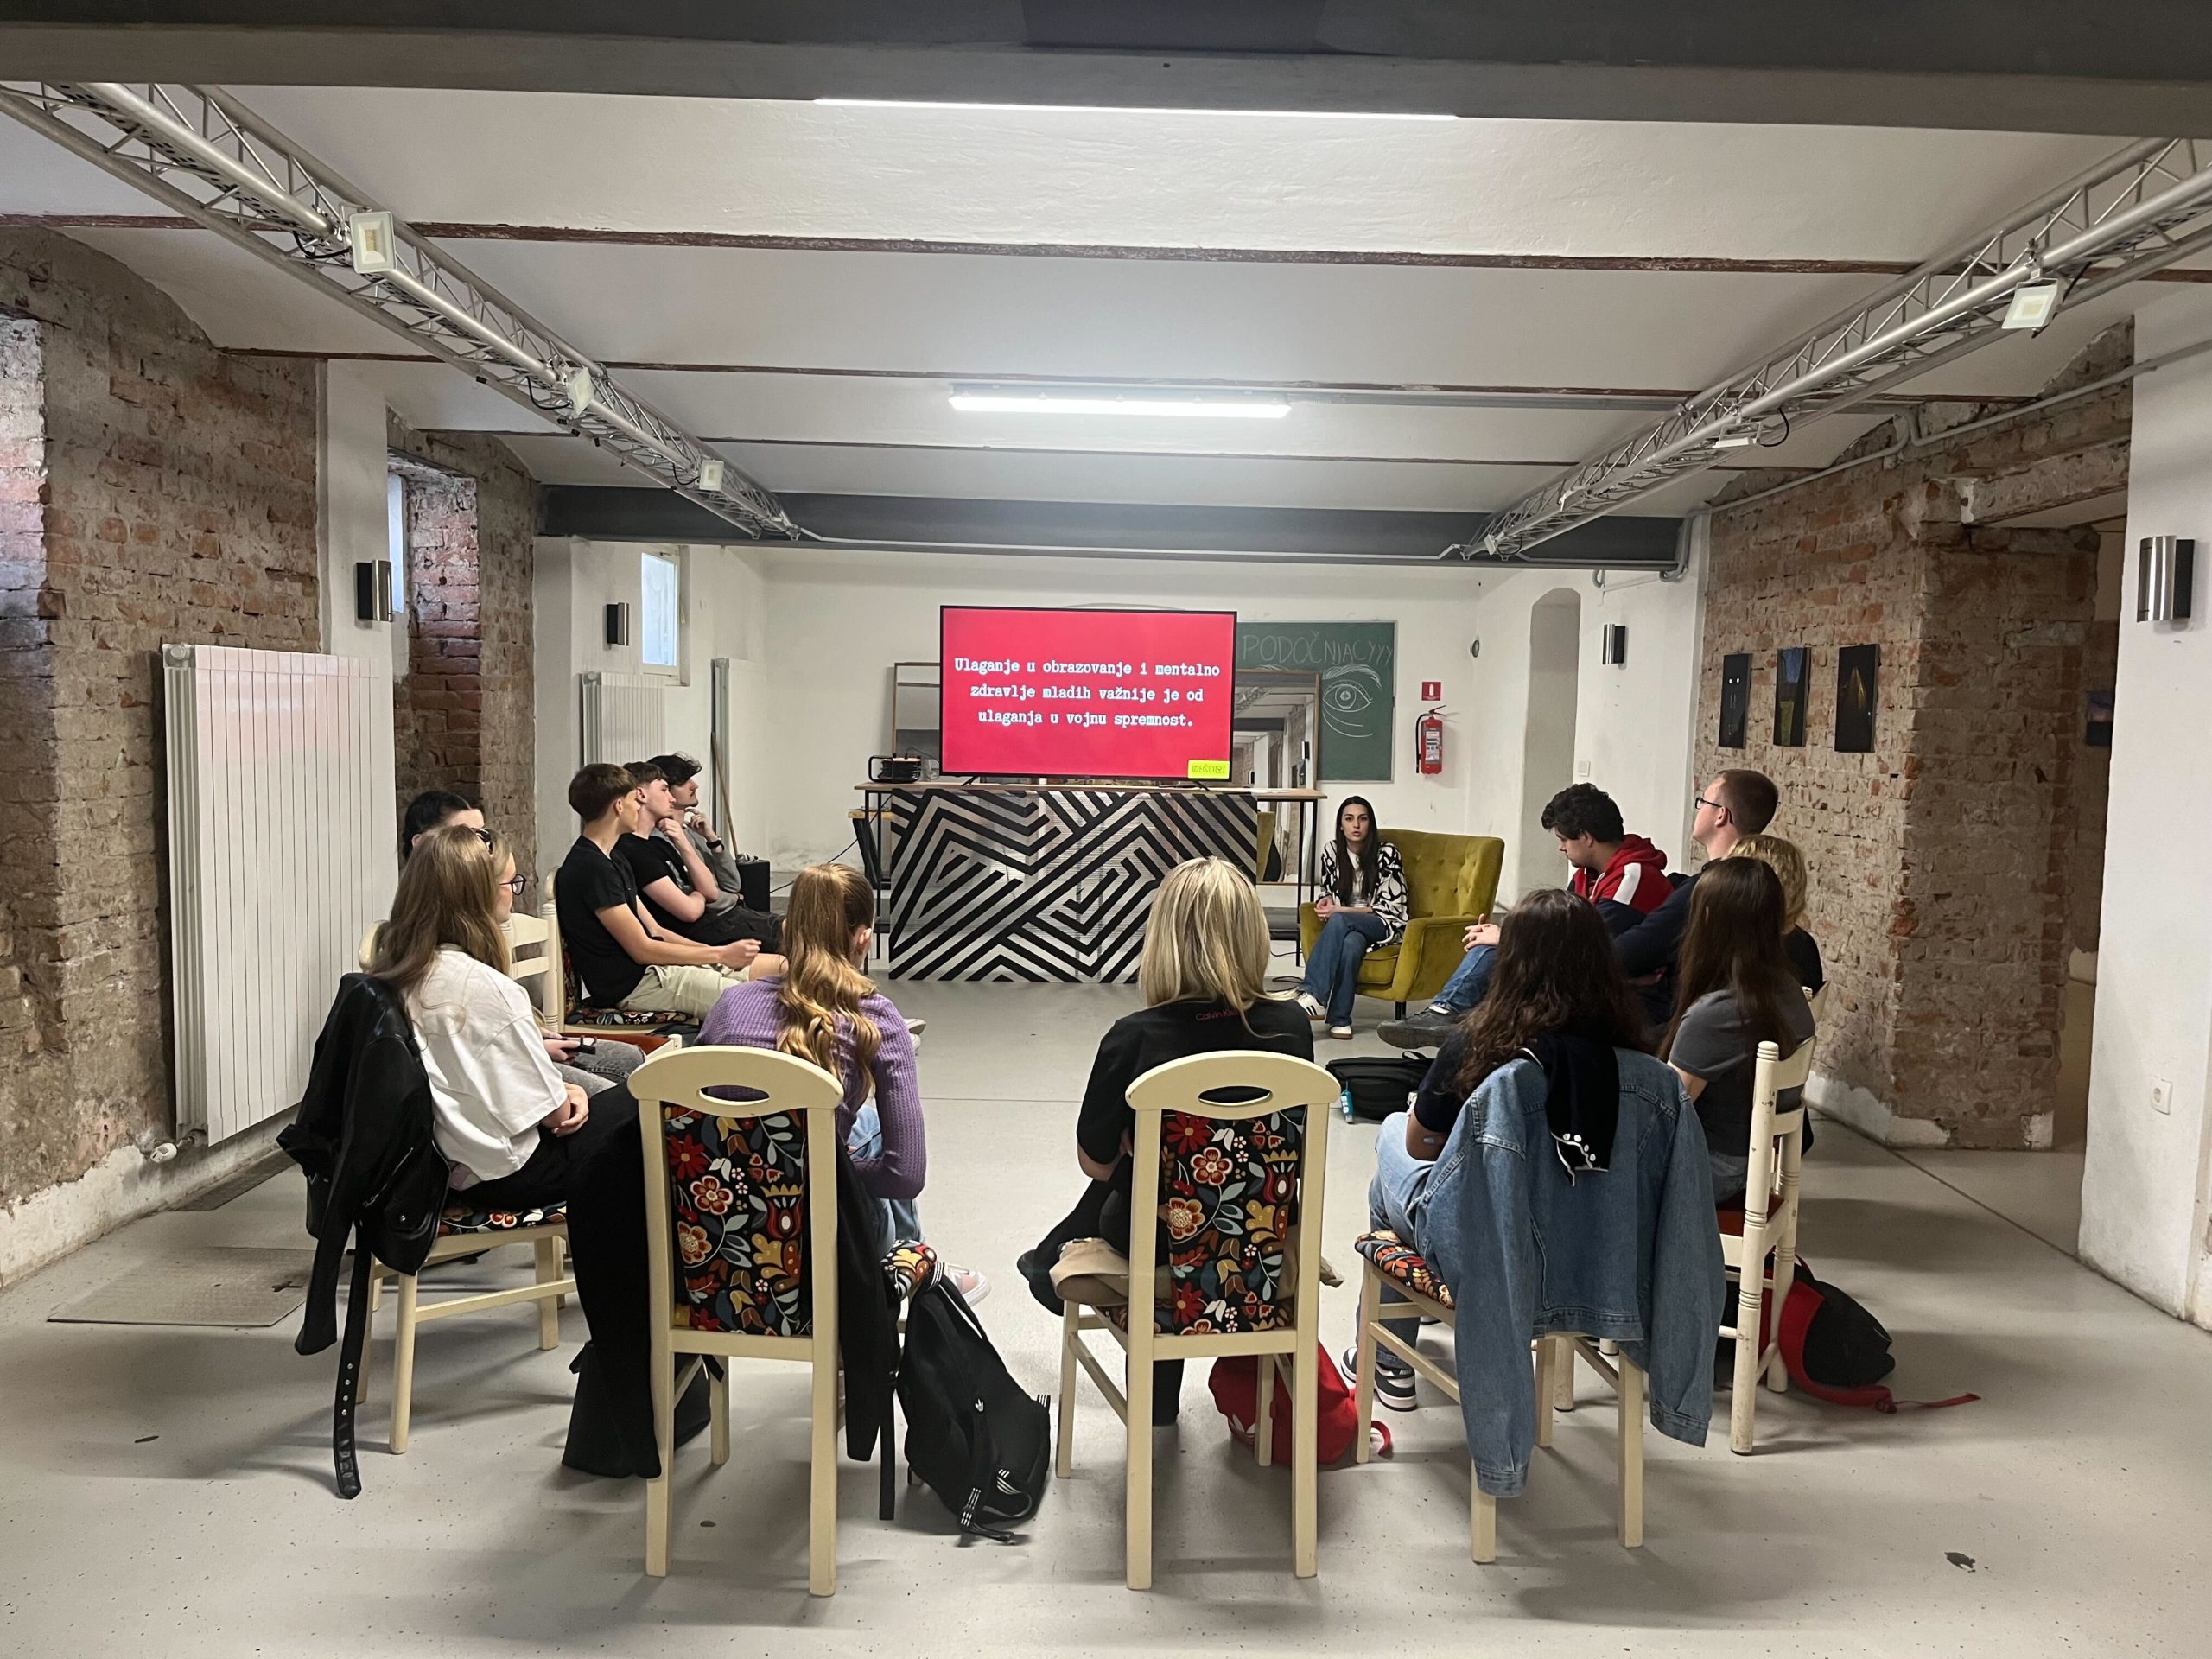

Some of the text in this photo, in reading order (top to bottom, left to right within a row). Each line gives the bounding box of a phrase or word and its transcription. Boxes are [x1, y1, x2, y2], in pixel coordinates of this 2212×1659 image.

[954, 657, 1221, 677] Ulaganje u obrazovanje i mentalno
[969, 683, 1204, 704] zdravlje mladih važnije je od
[978, 709, 1193, 728] ulaganja u vojnu spremnost.
[1196, 1010, 1223, 1021] Calvin
